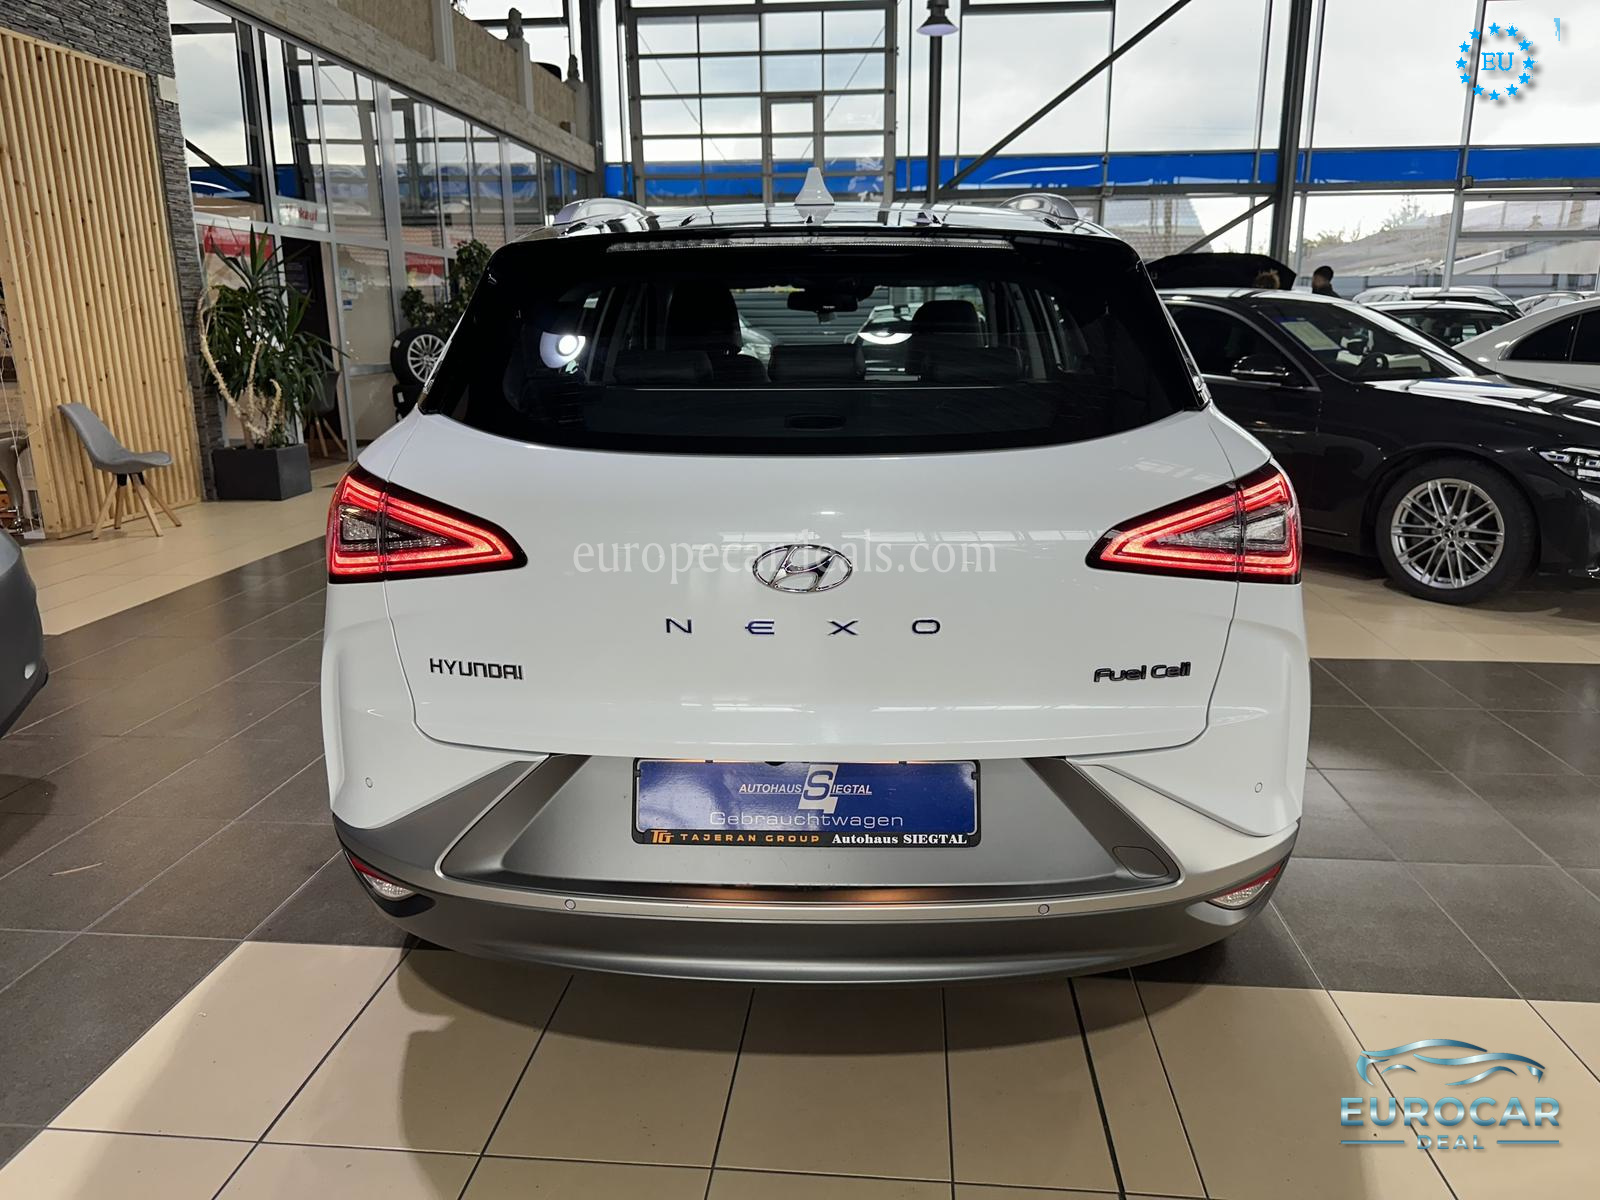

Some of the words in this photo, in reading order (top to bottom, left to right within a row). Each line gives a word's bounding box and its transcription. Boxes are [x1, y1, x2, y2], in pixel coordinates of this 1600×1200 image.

[666, 618, 941, 635] NEXO
[429, 658, 524, 680] HYUNDAI
[1093, 664, 1147, 683] Fuel
[1150, 661, 1192, 679] Cell
[739, 784, 802, 794] AUTOHAUS
[710, 811, 903, 829] Gebrauchtwagen
[680, 833, 756, 842] TAJERAN
[765, 834, 820, 843] GROUP
[831, 834, 899, 844] Autohaus
[903, 834, 968, 845] SIEGTAL
